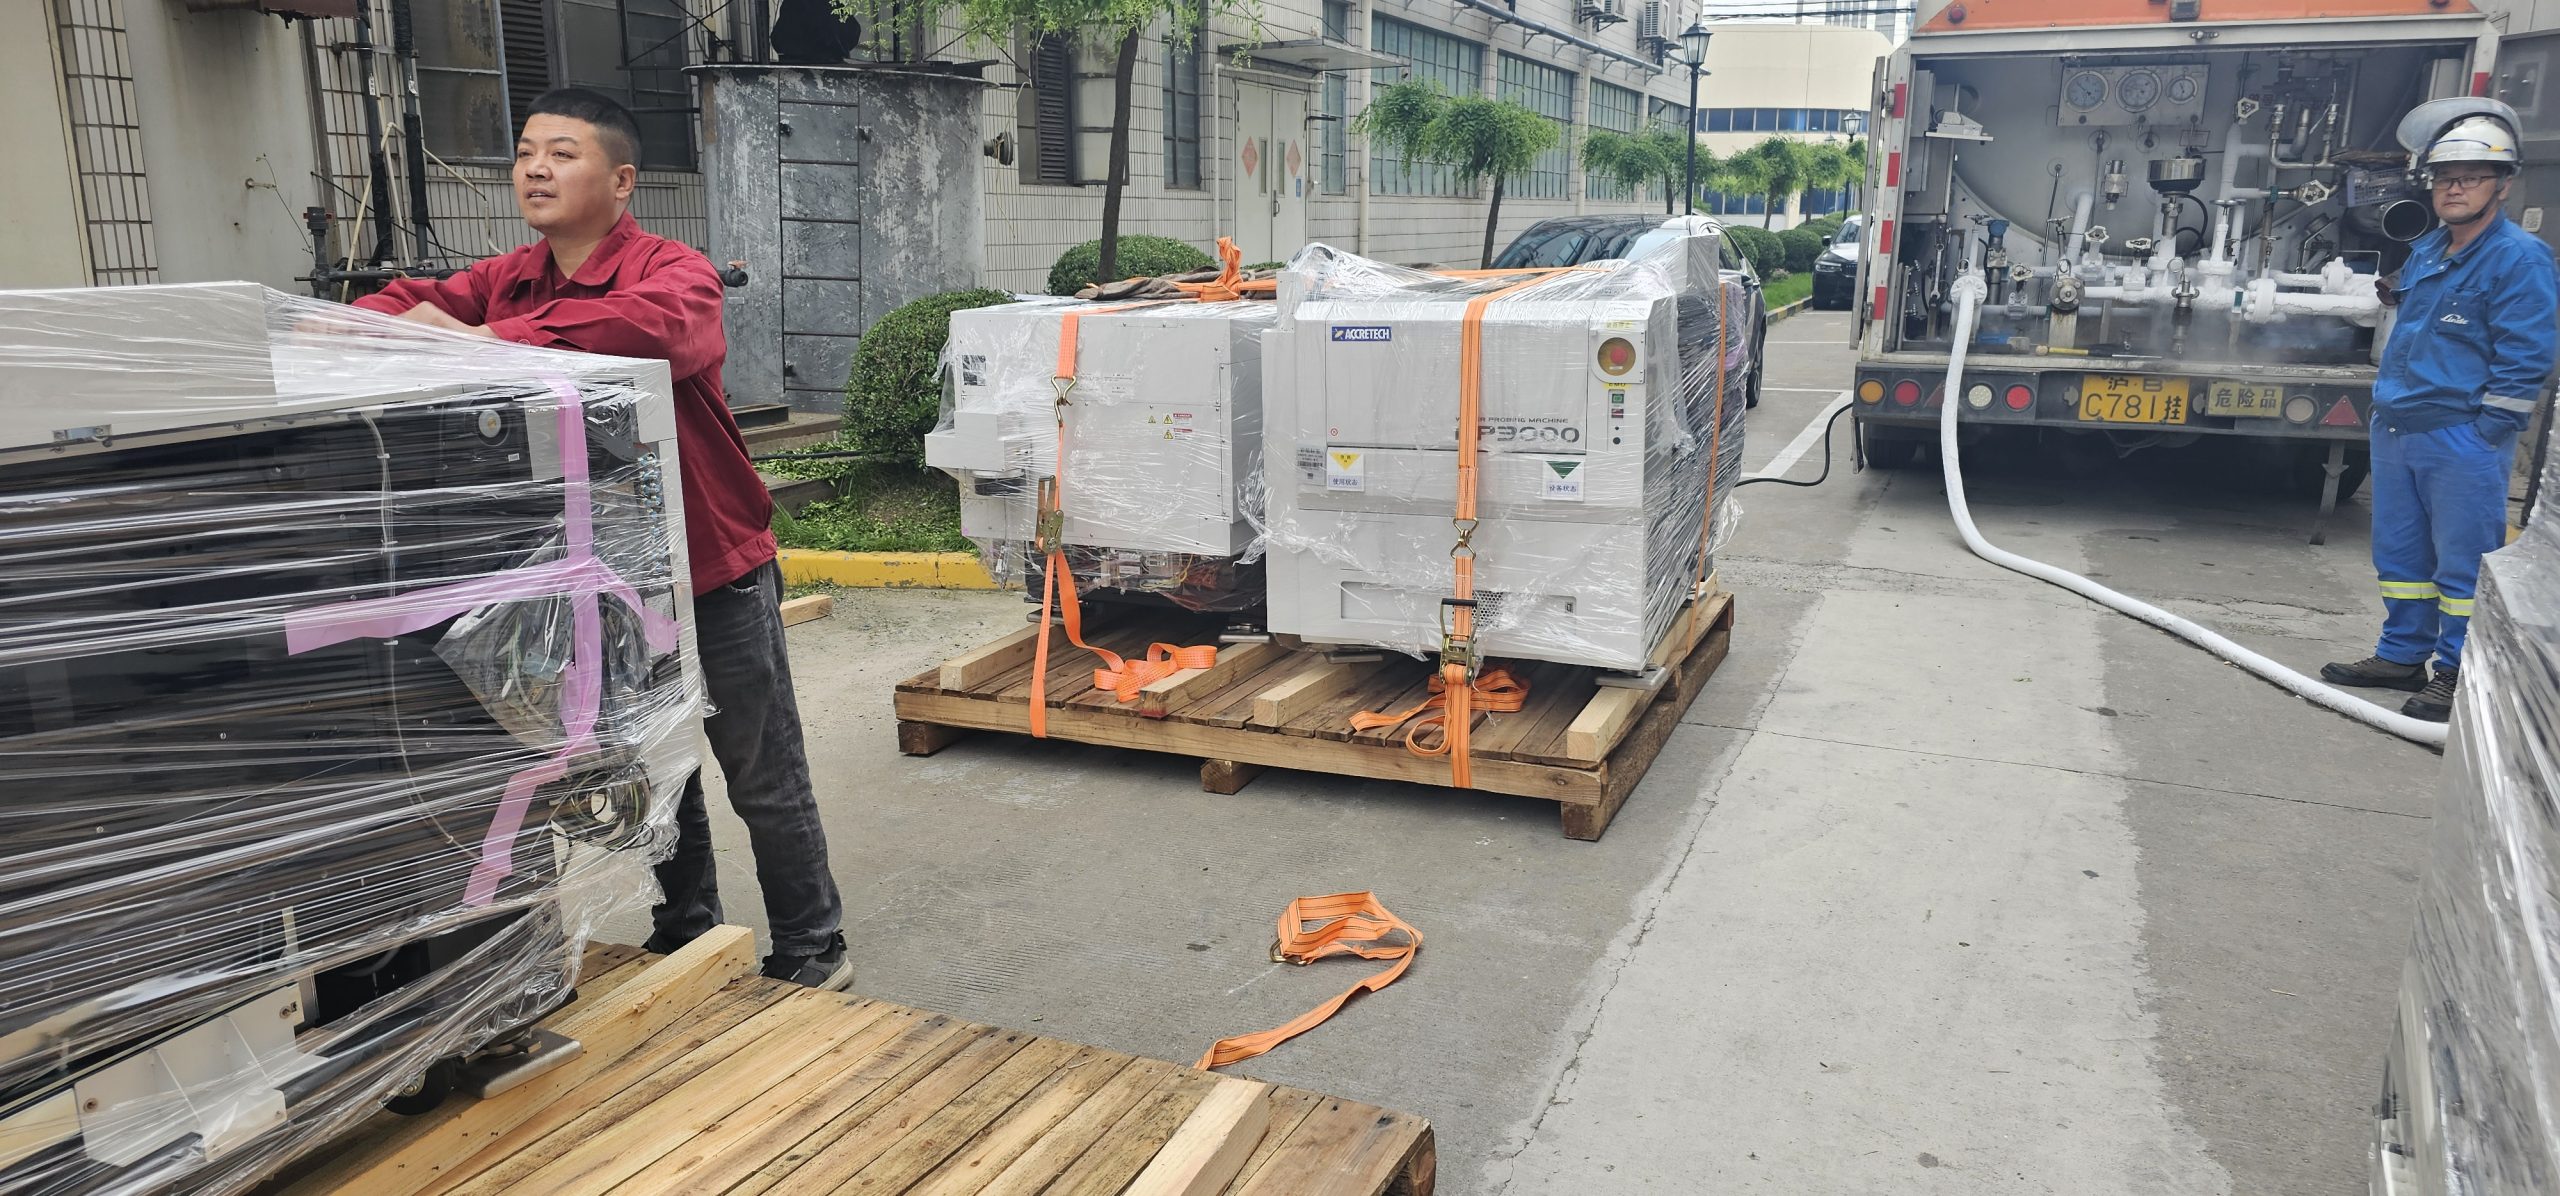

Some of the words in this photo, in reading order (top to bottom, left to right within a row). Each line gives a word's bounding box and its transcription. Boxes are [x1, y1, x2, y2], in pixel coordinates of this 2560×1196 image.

[1345, 328, 1390, 340] ACCRETECH
[2085, 393, 2182, 420] C781挂
[2214, 387, 2277, 409] 危险品
[1455, 425, 1580, 443] P3000
